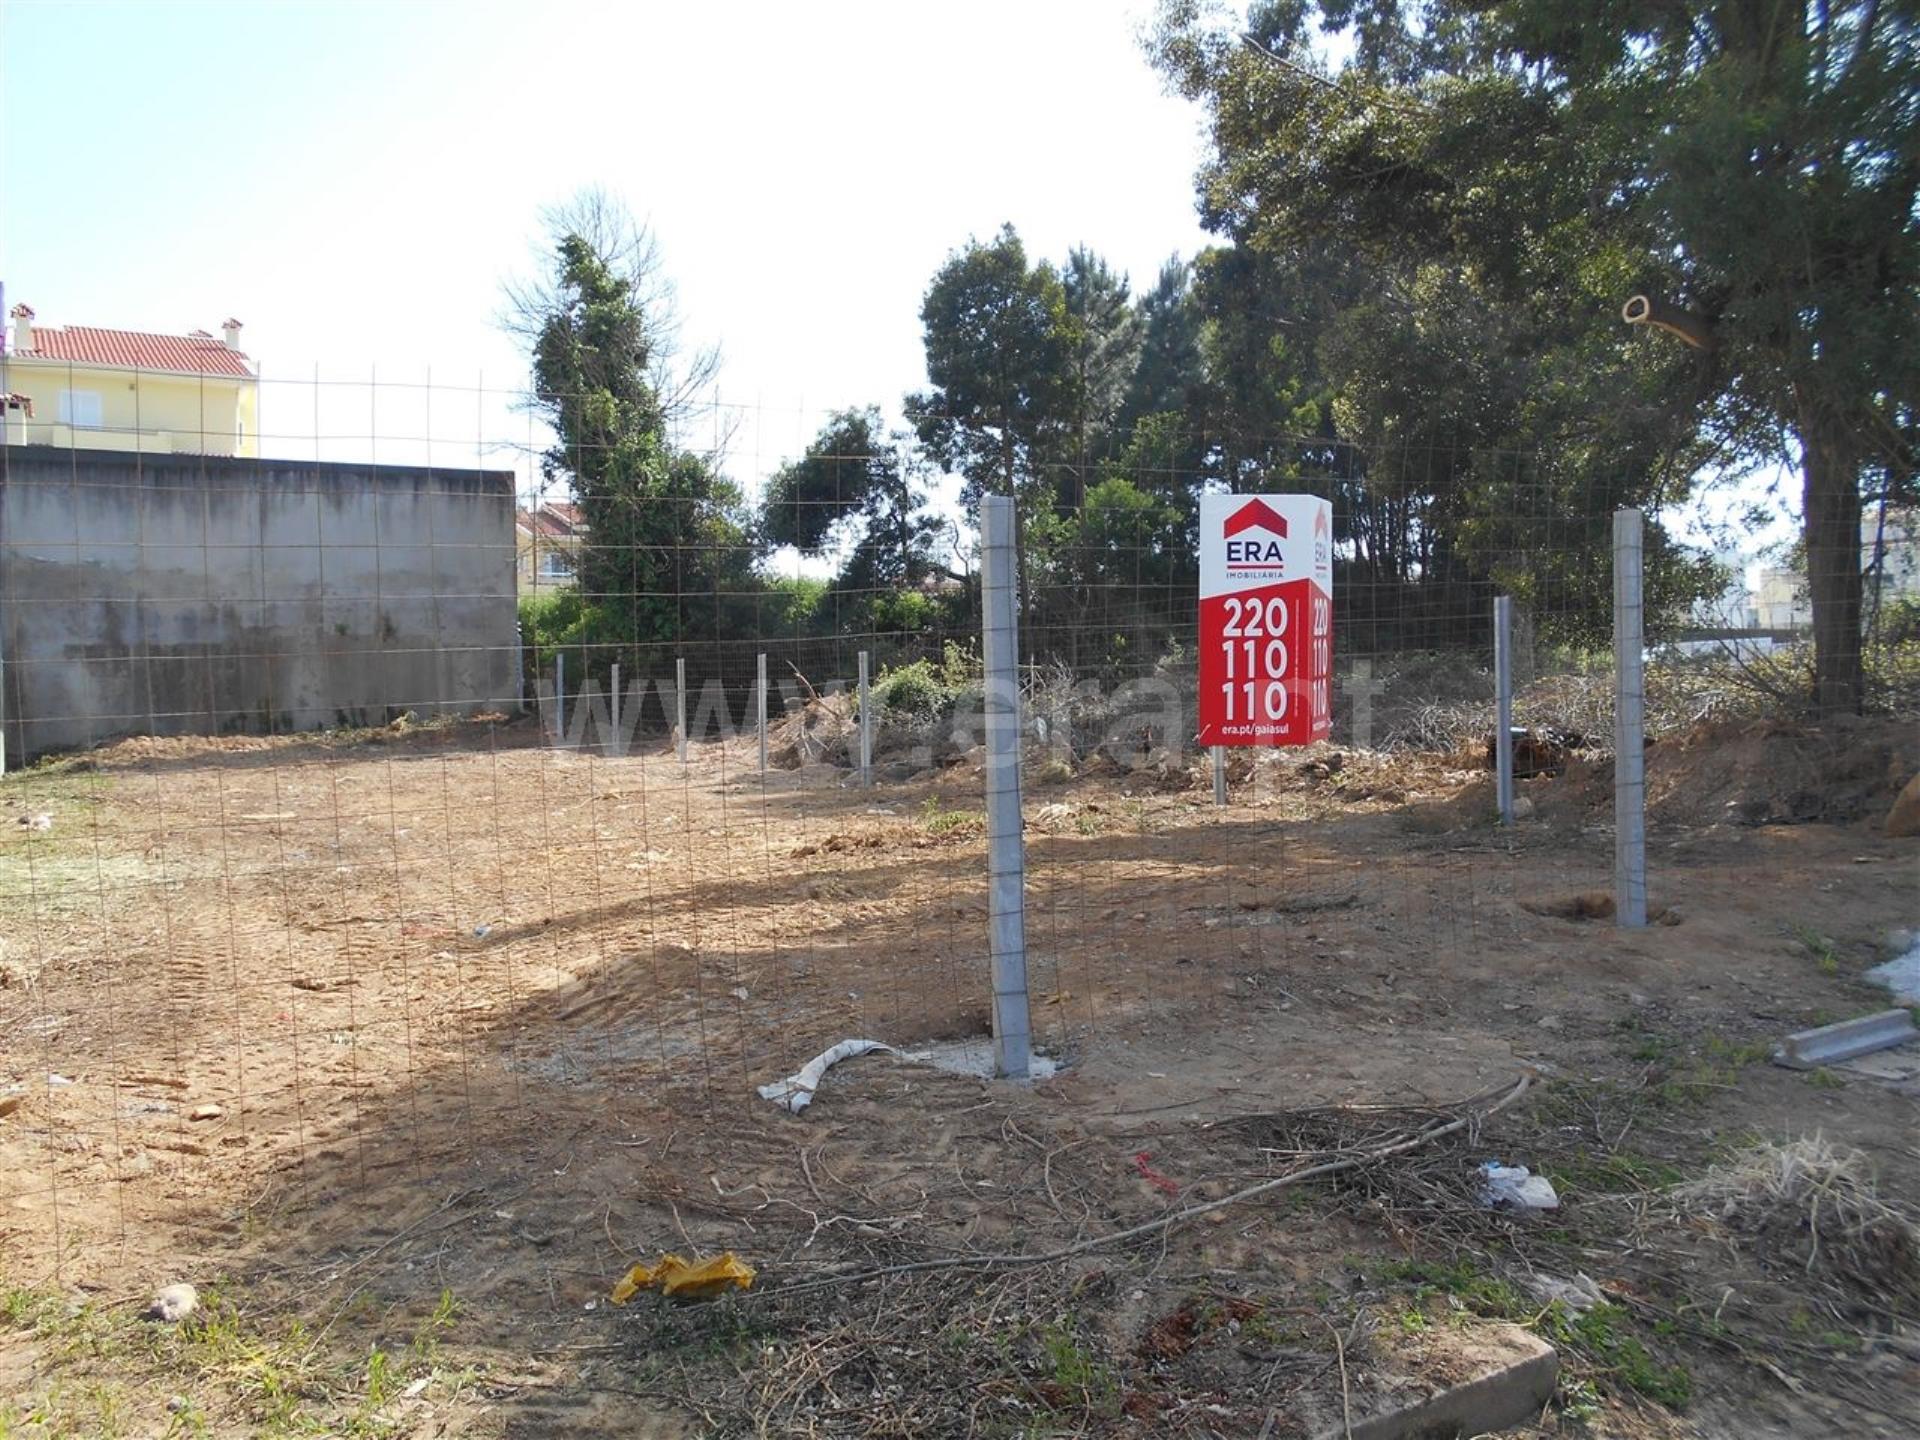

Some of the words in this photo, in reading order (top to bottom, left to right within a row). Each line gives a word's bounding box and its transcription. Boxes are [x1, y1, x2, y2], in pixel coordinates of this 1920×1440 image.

[1227, 541, 1283, 562] ERA
[1222, 597, 1288, 638] 220
[1222, 639, 1288, 679] 110
[1222, 681, 1288, 721] 110
[1221, 723, 1289, 736] era.pt/gaiasul
